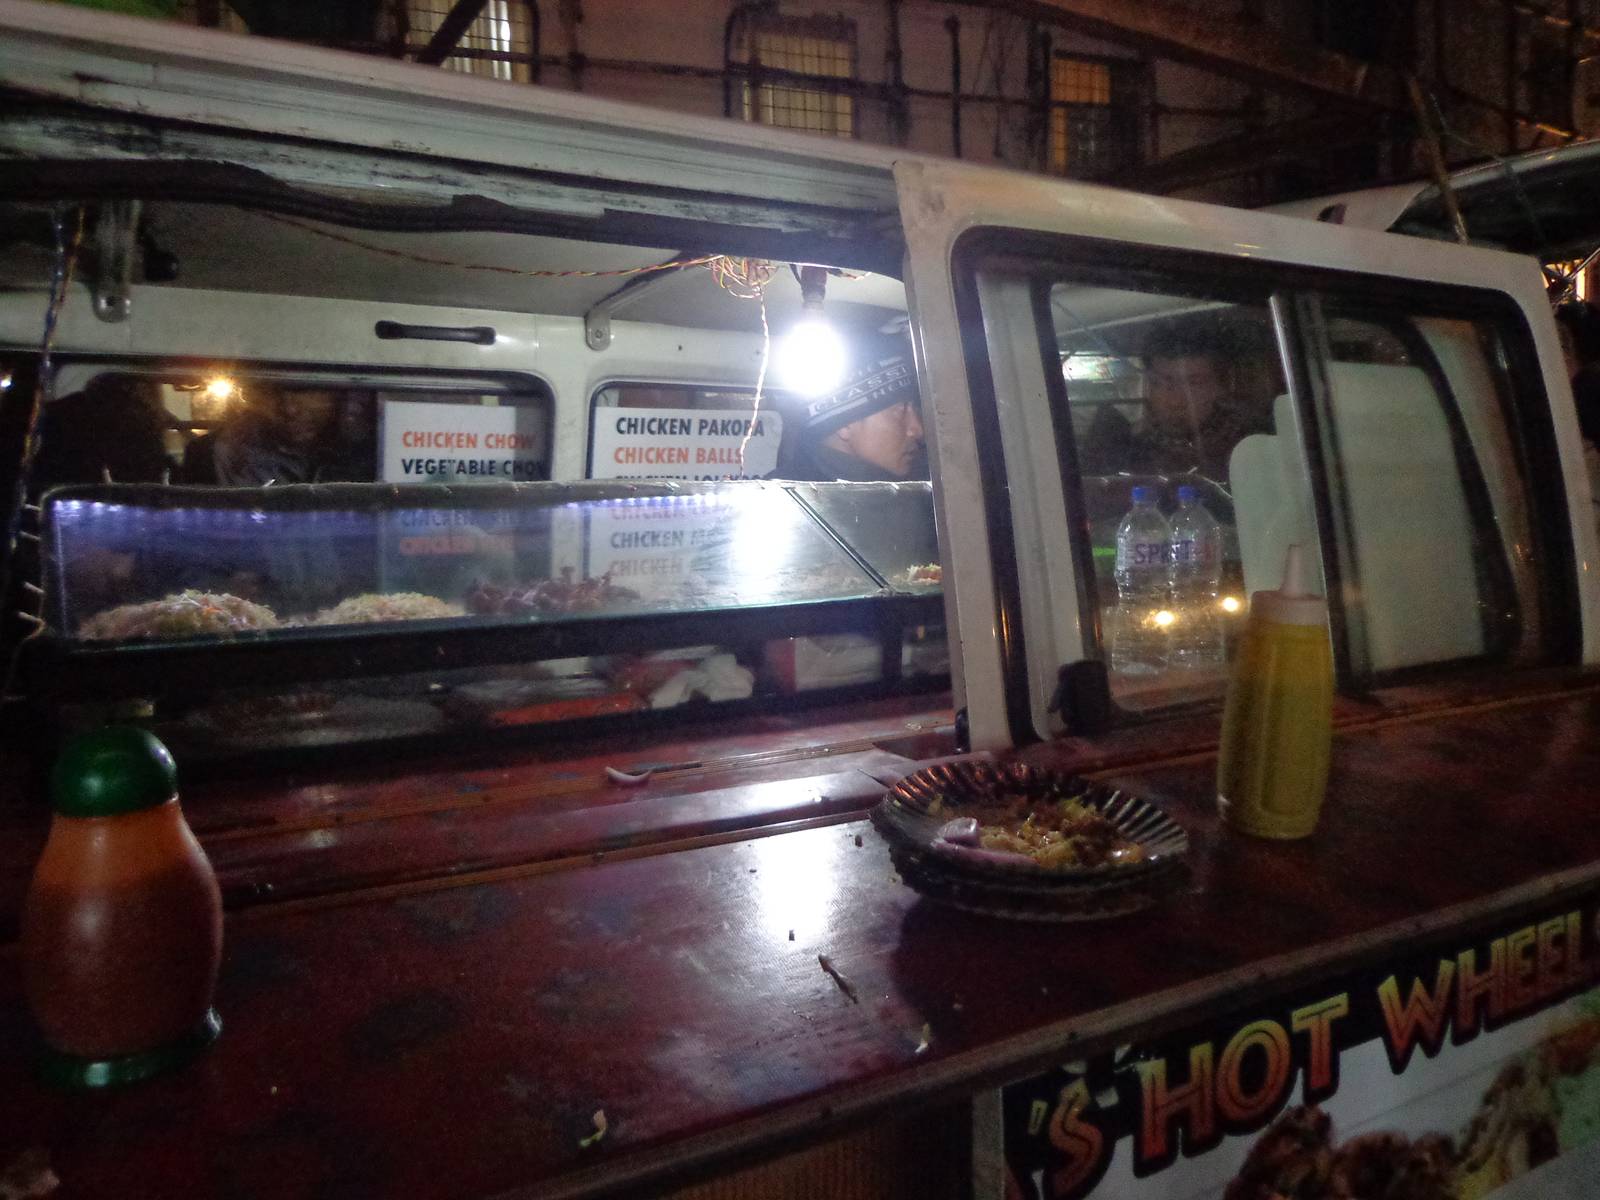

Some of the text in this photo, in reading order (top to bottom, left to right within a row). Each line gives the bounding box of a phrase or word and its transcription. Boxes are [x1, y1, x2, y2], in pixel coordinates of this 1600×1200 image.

[616, 416, 691, 436] CHICKEN
[402, 431, 478, 449] CHICKEN
[614, 446, 743, 465] CHICKEN BALLS
[609, 530, 685, 549] CHICKEN
[1137, 992, 1350, 1161] HOT
[1377, 908, 1600, 1062] WHEEL
